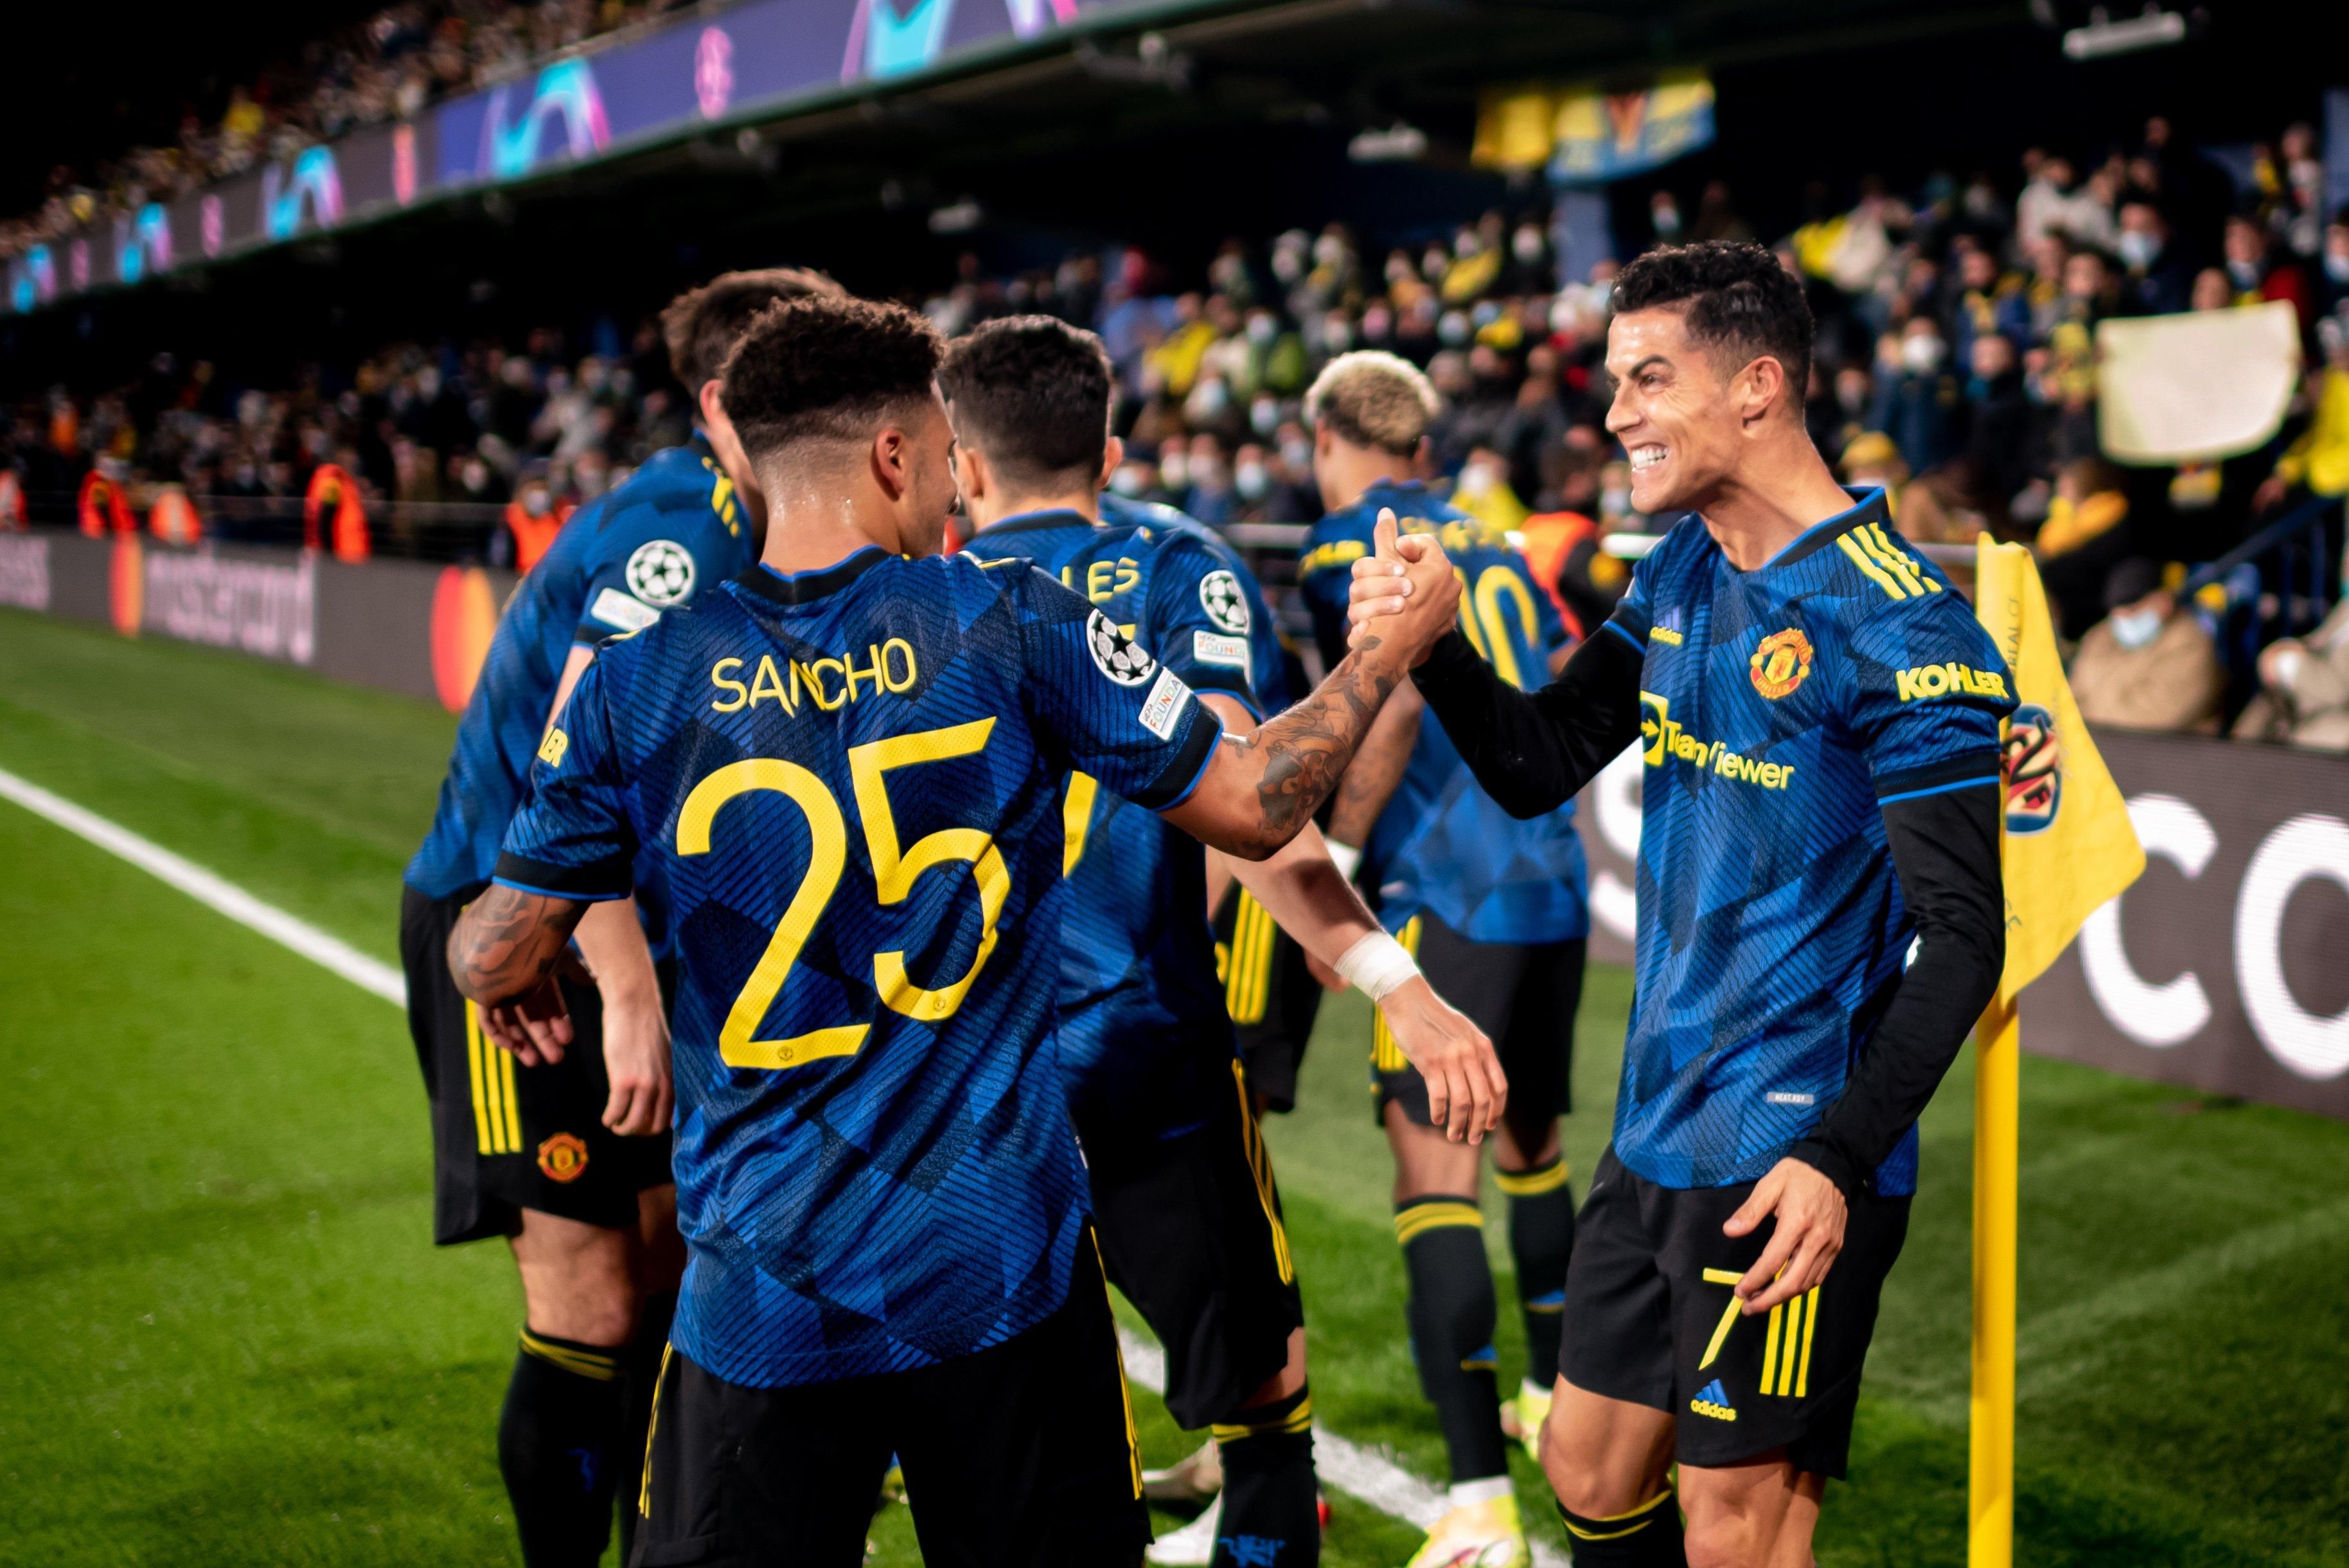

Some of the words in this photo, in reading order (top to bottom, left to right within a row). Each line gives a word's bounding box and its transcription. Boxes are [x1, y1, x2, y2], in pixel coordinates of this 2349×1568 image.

[1650, 626, 1682, 645] adidas
[711, 638, 916, 718] SANCHO
[1896, 662, 2010, 701] KOHLER
[677, 716, 1011, 1070] 25
[1699, 1267, 1745, 1371] 7
[1690, 1399, 1737, 1422] adidas
